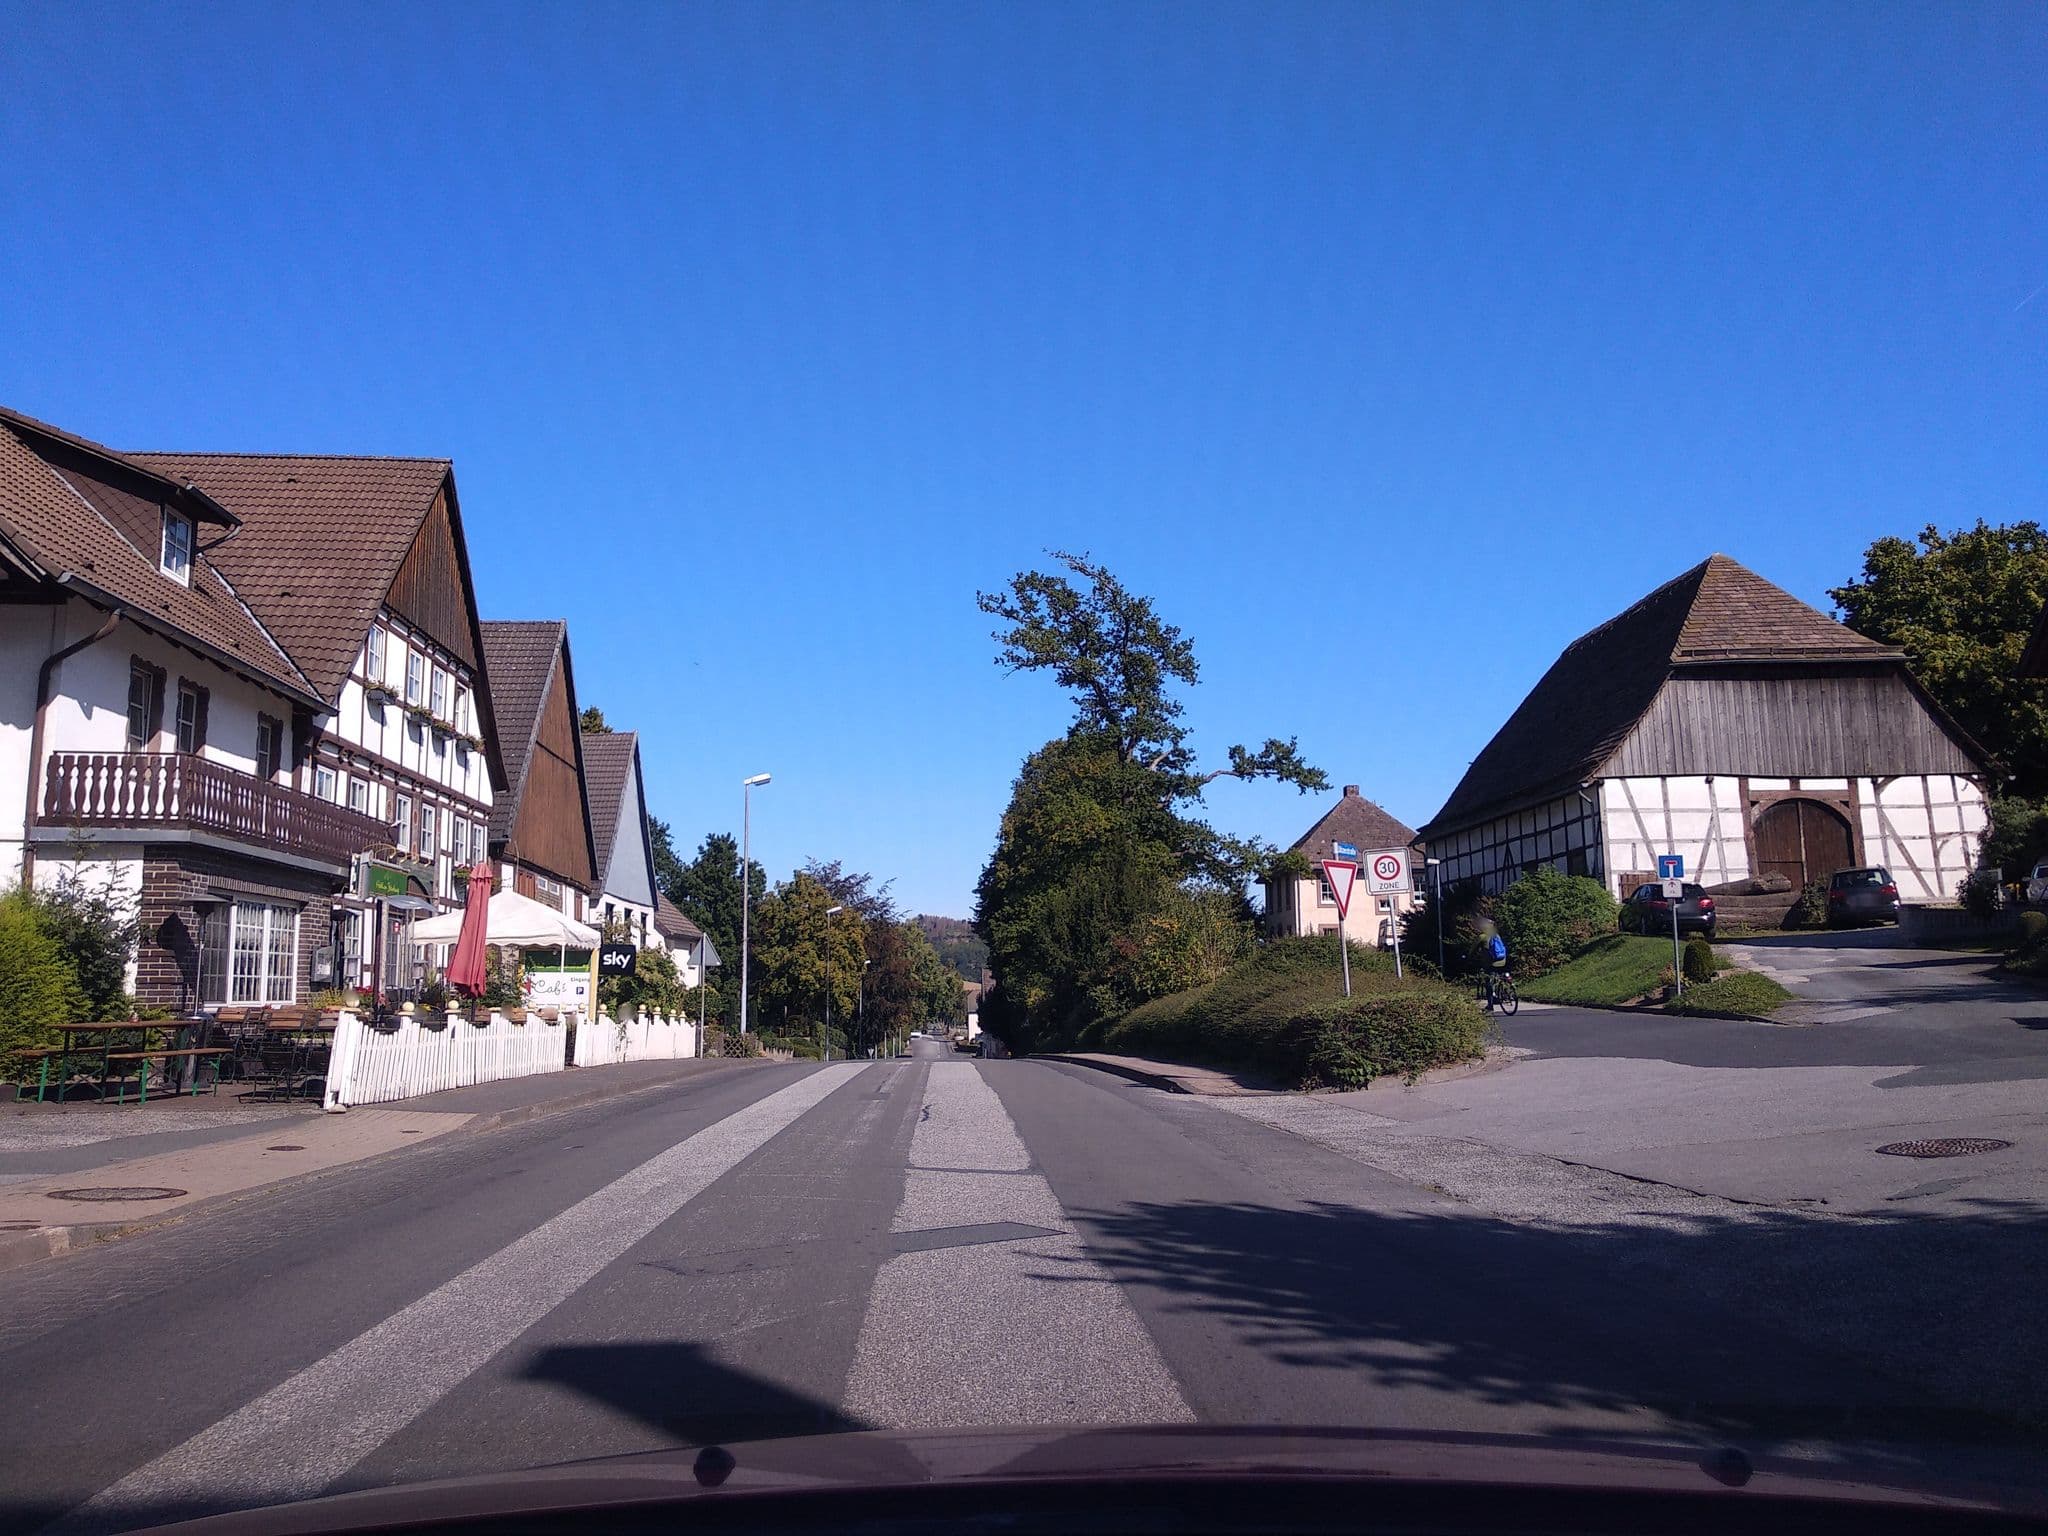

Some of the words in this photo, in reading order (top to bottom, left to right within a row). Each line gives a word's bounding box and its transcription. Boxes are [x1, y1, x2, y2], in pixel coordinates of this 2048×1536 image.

[1379, 861, 1395, 874] 30
[1379, 881, 1400, 890] ZONE
[602, 951, 631, 969] sky
